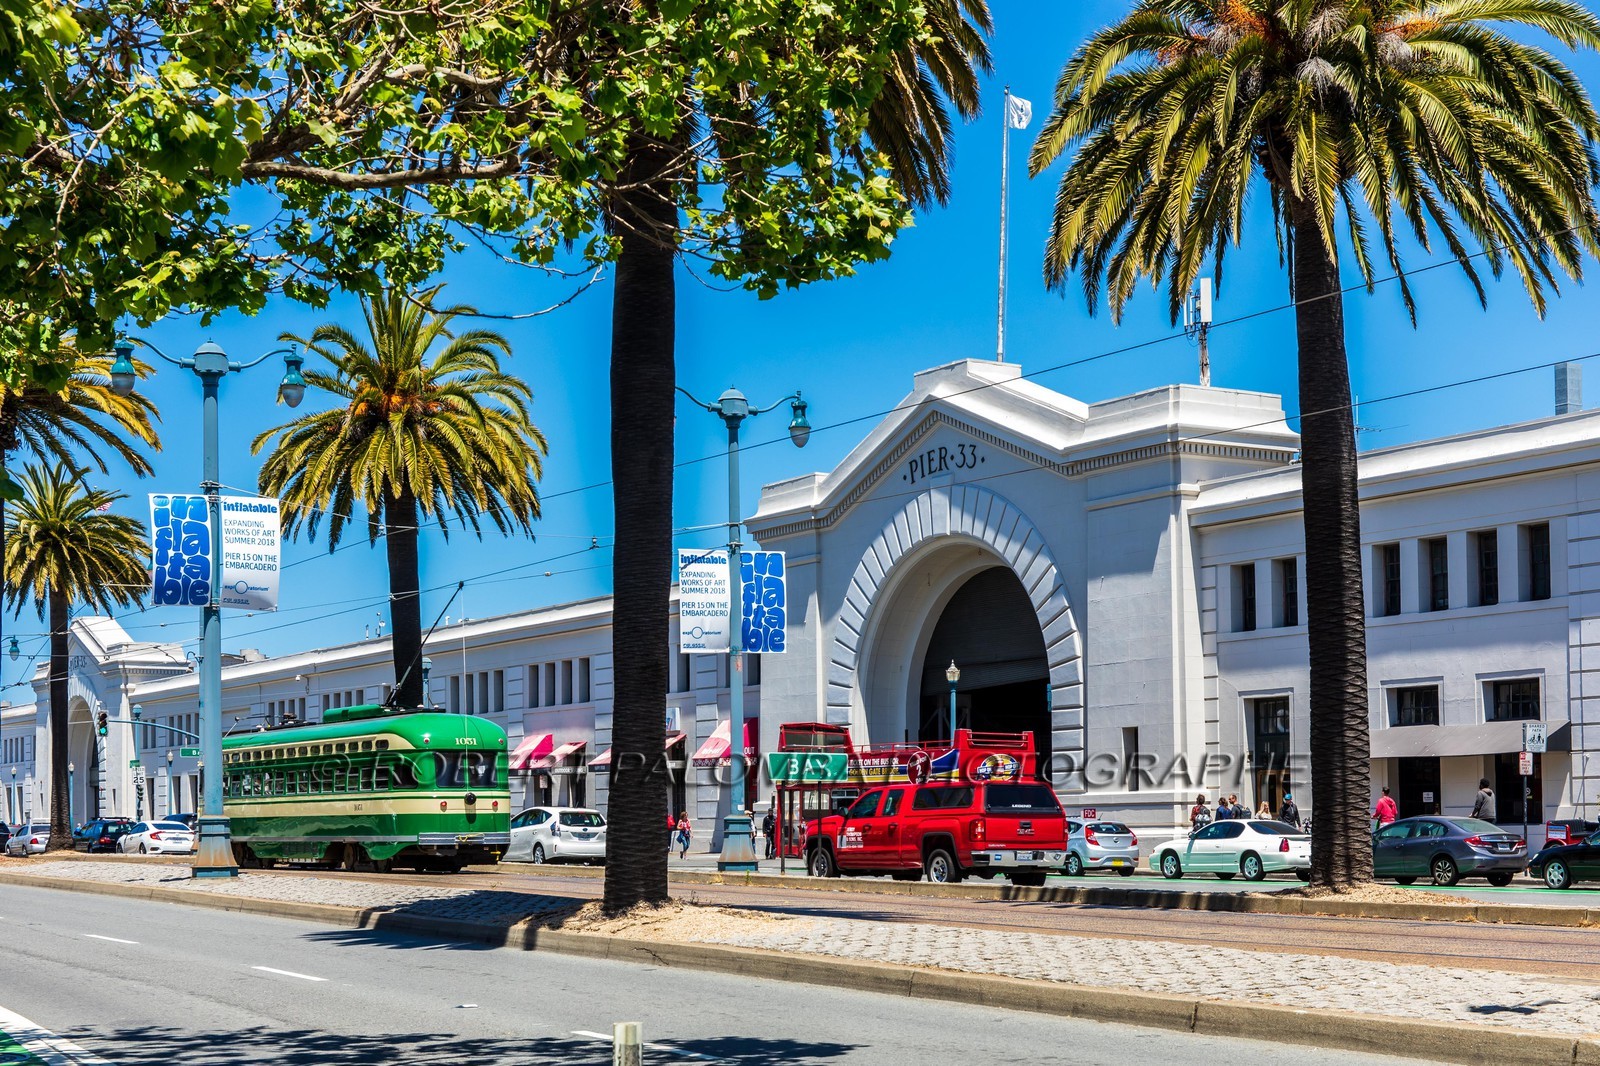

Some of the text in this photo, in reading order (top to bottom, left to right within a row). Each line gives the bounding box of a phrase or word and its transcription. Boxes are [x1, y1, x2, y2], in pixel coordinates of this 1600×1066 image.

[909, 446, 950, 485] PIER
[223, 501, 277, 513] inflatable
[224, 519, 265, 528] EXPANDING
[224, 528, 276, 537] WORKS OF ART
[224, 536, 275, 546] SUMMER 2018
[225, 552, 277, 563] PIER 15 ON THE
[681, 554, 727, 565] inflatable
[225, 561, 277, 572] EMBARCADERO
[681, 609, 728, 617] EMBARCADERO
[788, 758, 828, 776] BAY
[872, 758, 880, 766] THE
[916, 764, 923, 776] 2
[133, 776, 145, 784] 25
[1084, 809, 1095, 818] FDC
